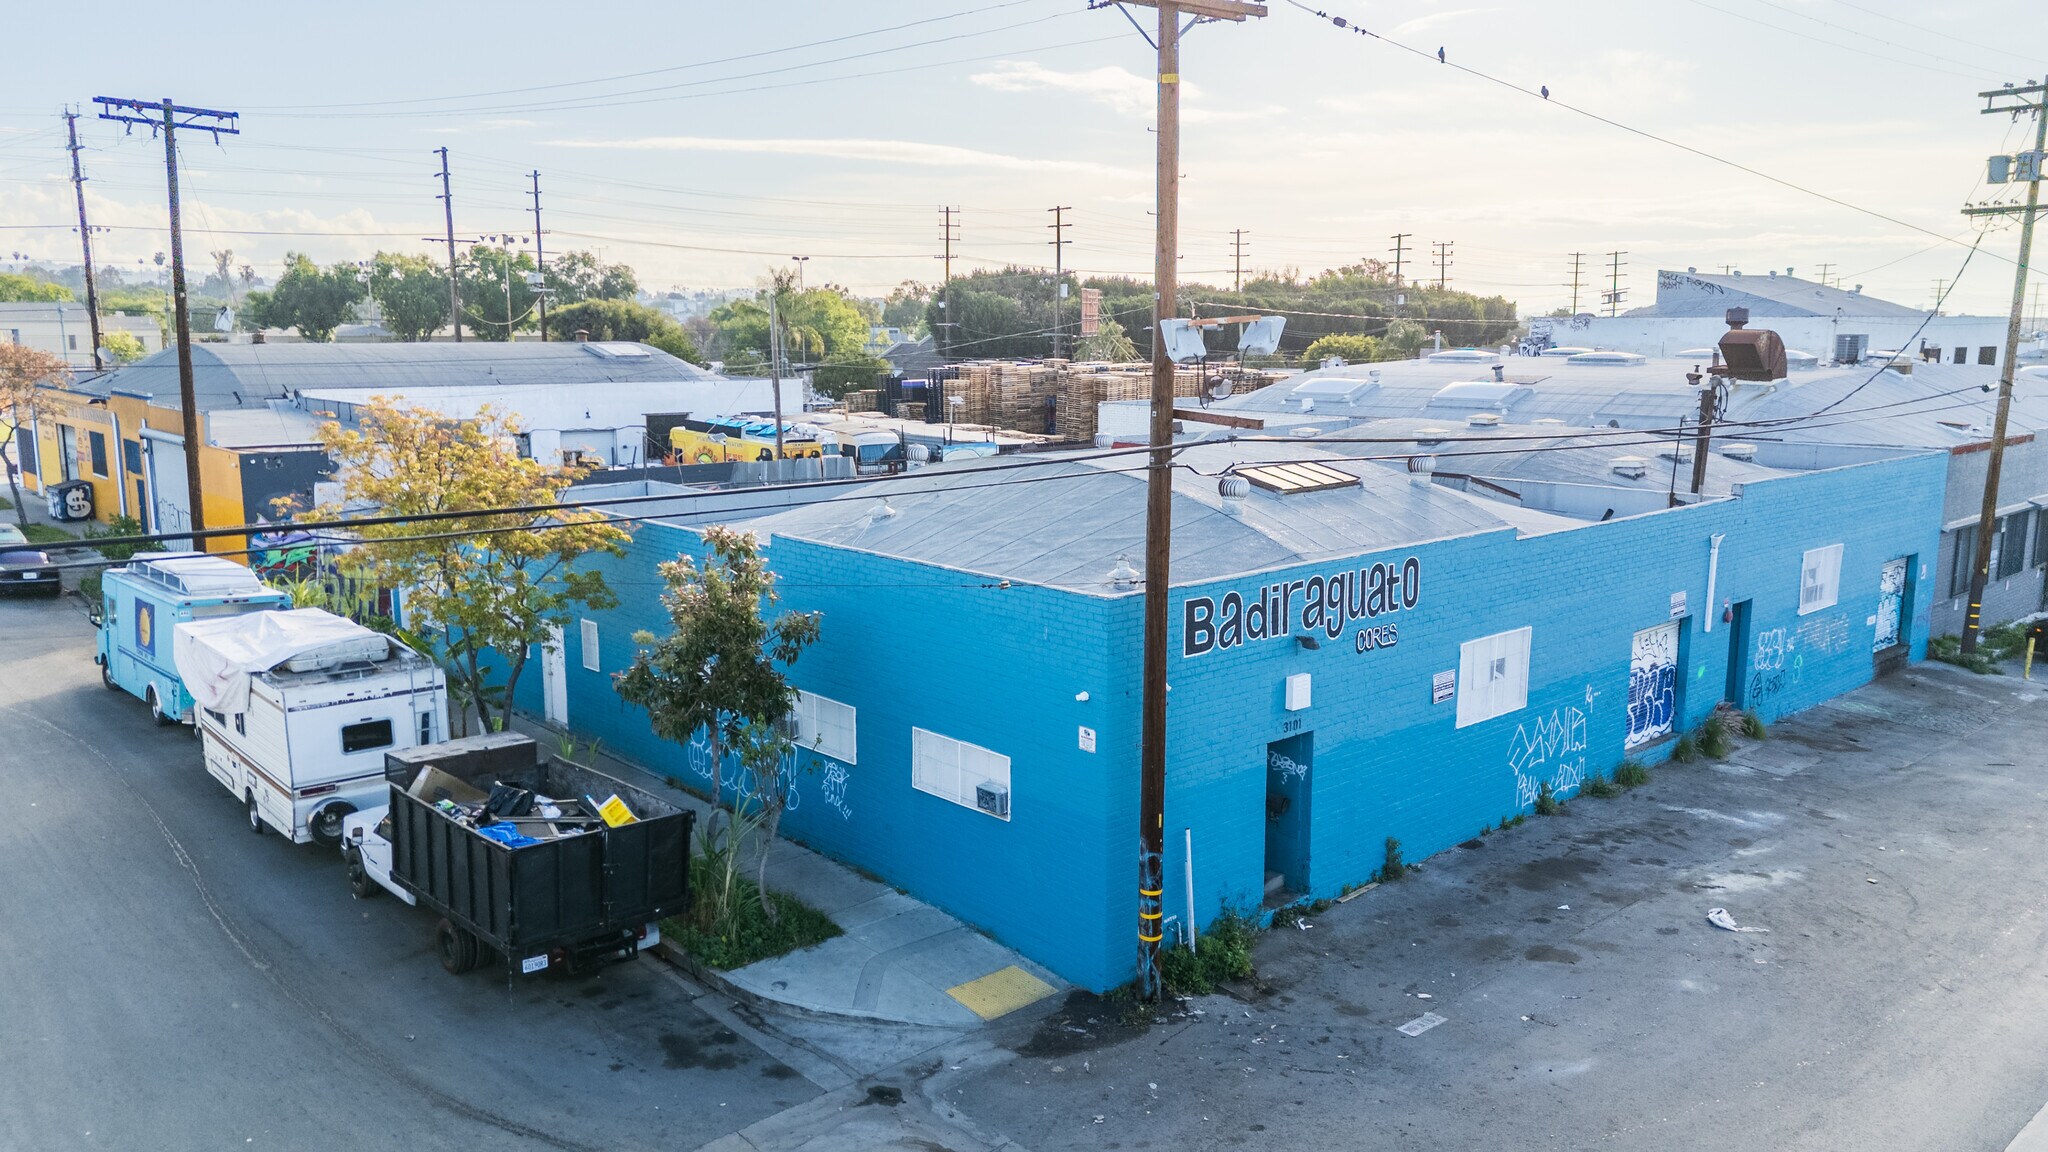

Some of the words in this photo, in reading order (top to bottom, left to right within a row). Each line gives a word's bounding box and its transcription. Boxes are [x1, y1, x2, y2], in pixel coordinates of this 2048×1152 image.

[1184, 556, 1420, 658] Badiraguato
[1356, 622, 1399, 653] CORES
[1283, 718, 1302, 733] 3101
